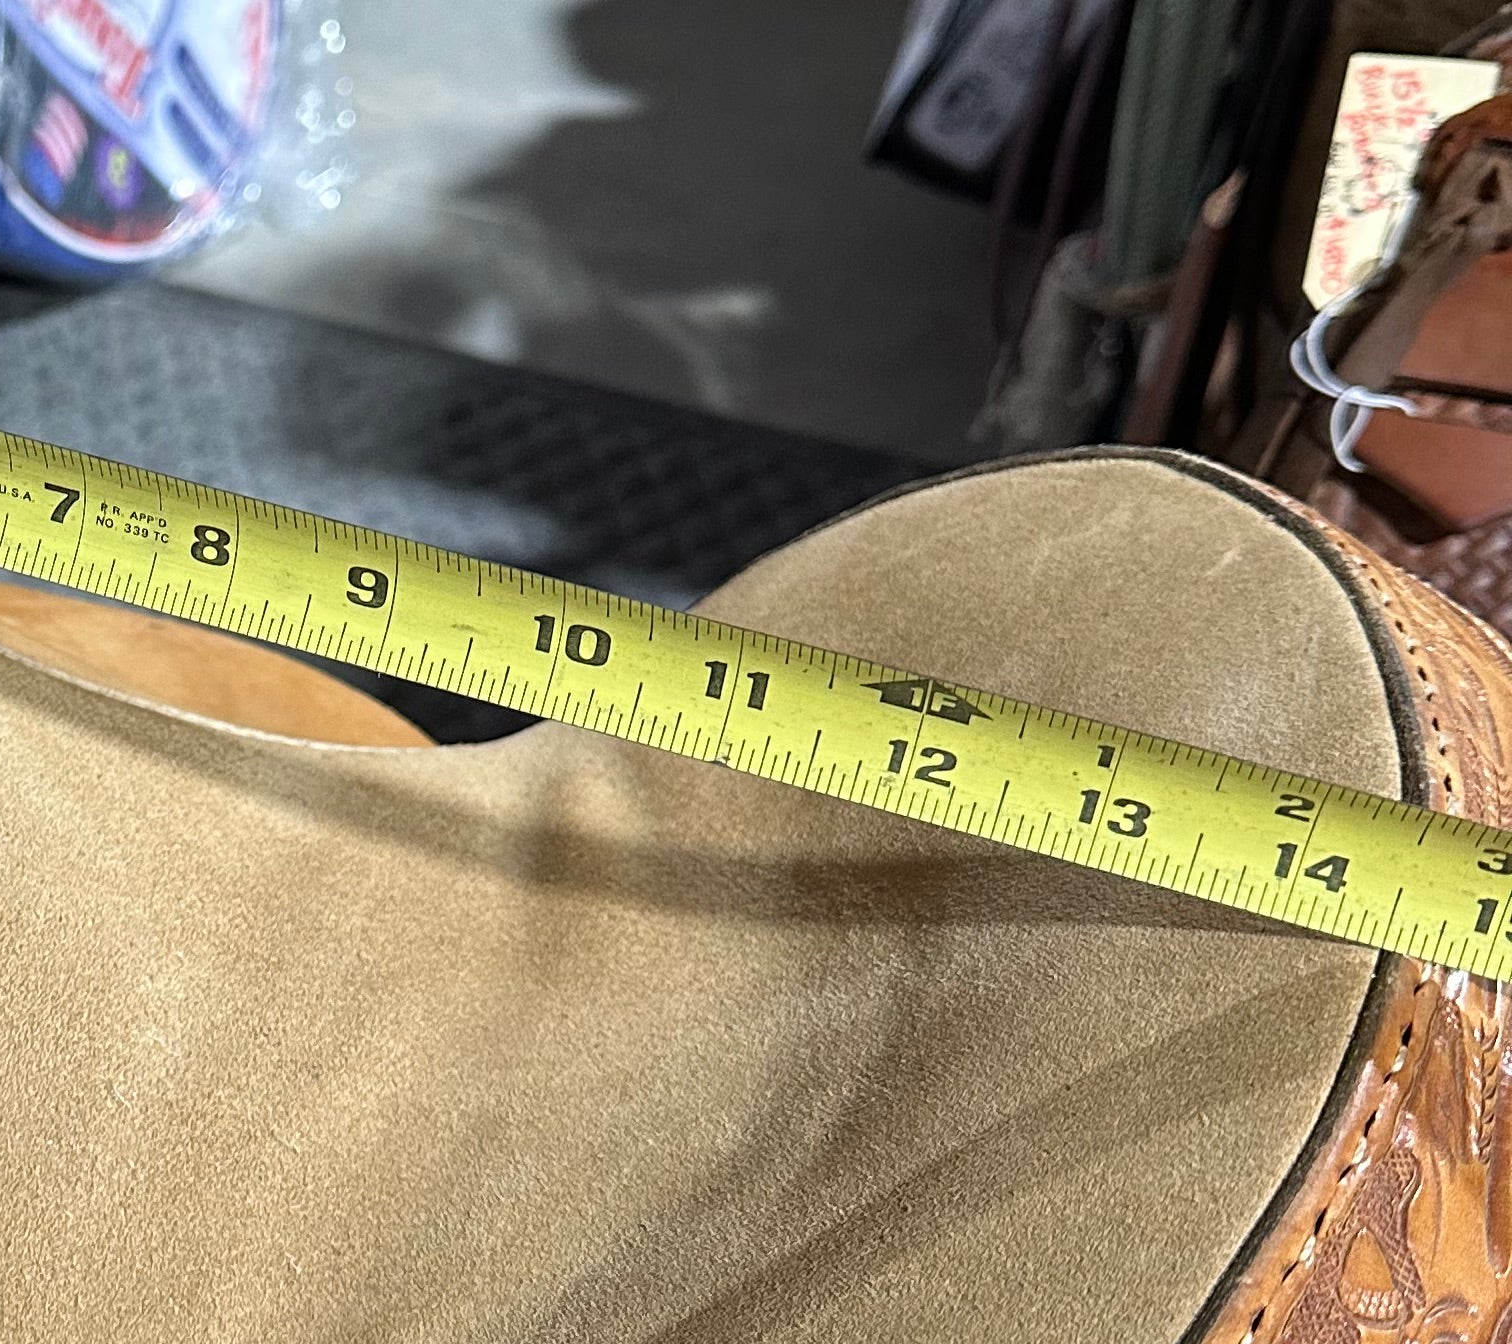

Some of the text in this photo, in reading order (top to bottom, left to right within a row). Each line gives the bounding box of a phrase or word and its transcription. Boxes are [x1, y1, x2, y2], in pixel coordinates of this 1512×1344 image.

[44, 482, 81, 524] 7
[123, 522, 149, 538] 339
[153, 531, 170, 545] TC
[190, 524, 231, 566] 8
[345, 565, 389, 609] 9
[534, 614, 612, 667] 10
[705, 660, 771, 711] 11
[909, 685, 958, 713] 1F
[887, 739, 959, 788] 12
[1096, 744, 1116, 769] 1
[1078, 788, 1152, 838] 13
[1274, 793, 1316, 823] 2
[1274, 842, 1350, 893] 14
[1476, 848, 1512, 875] 3
